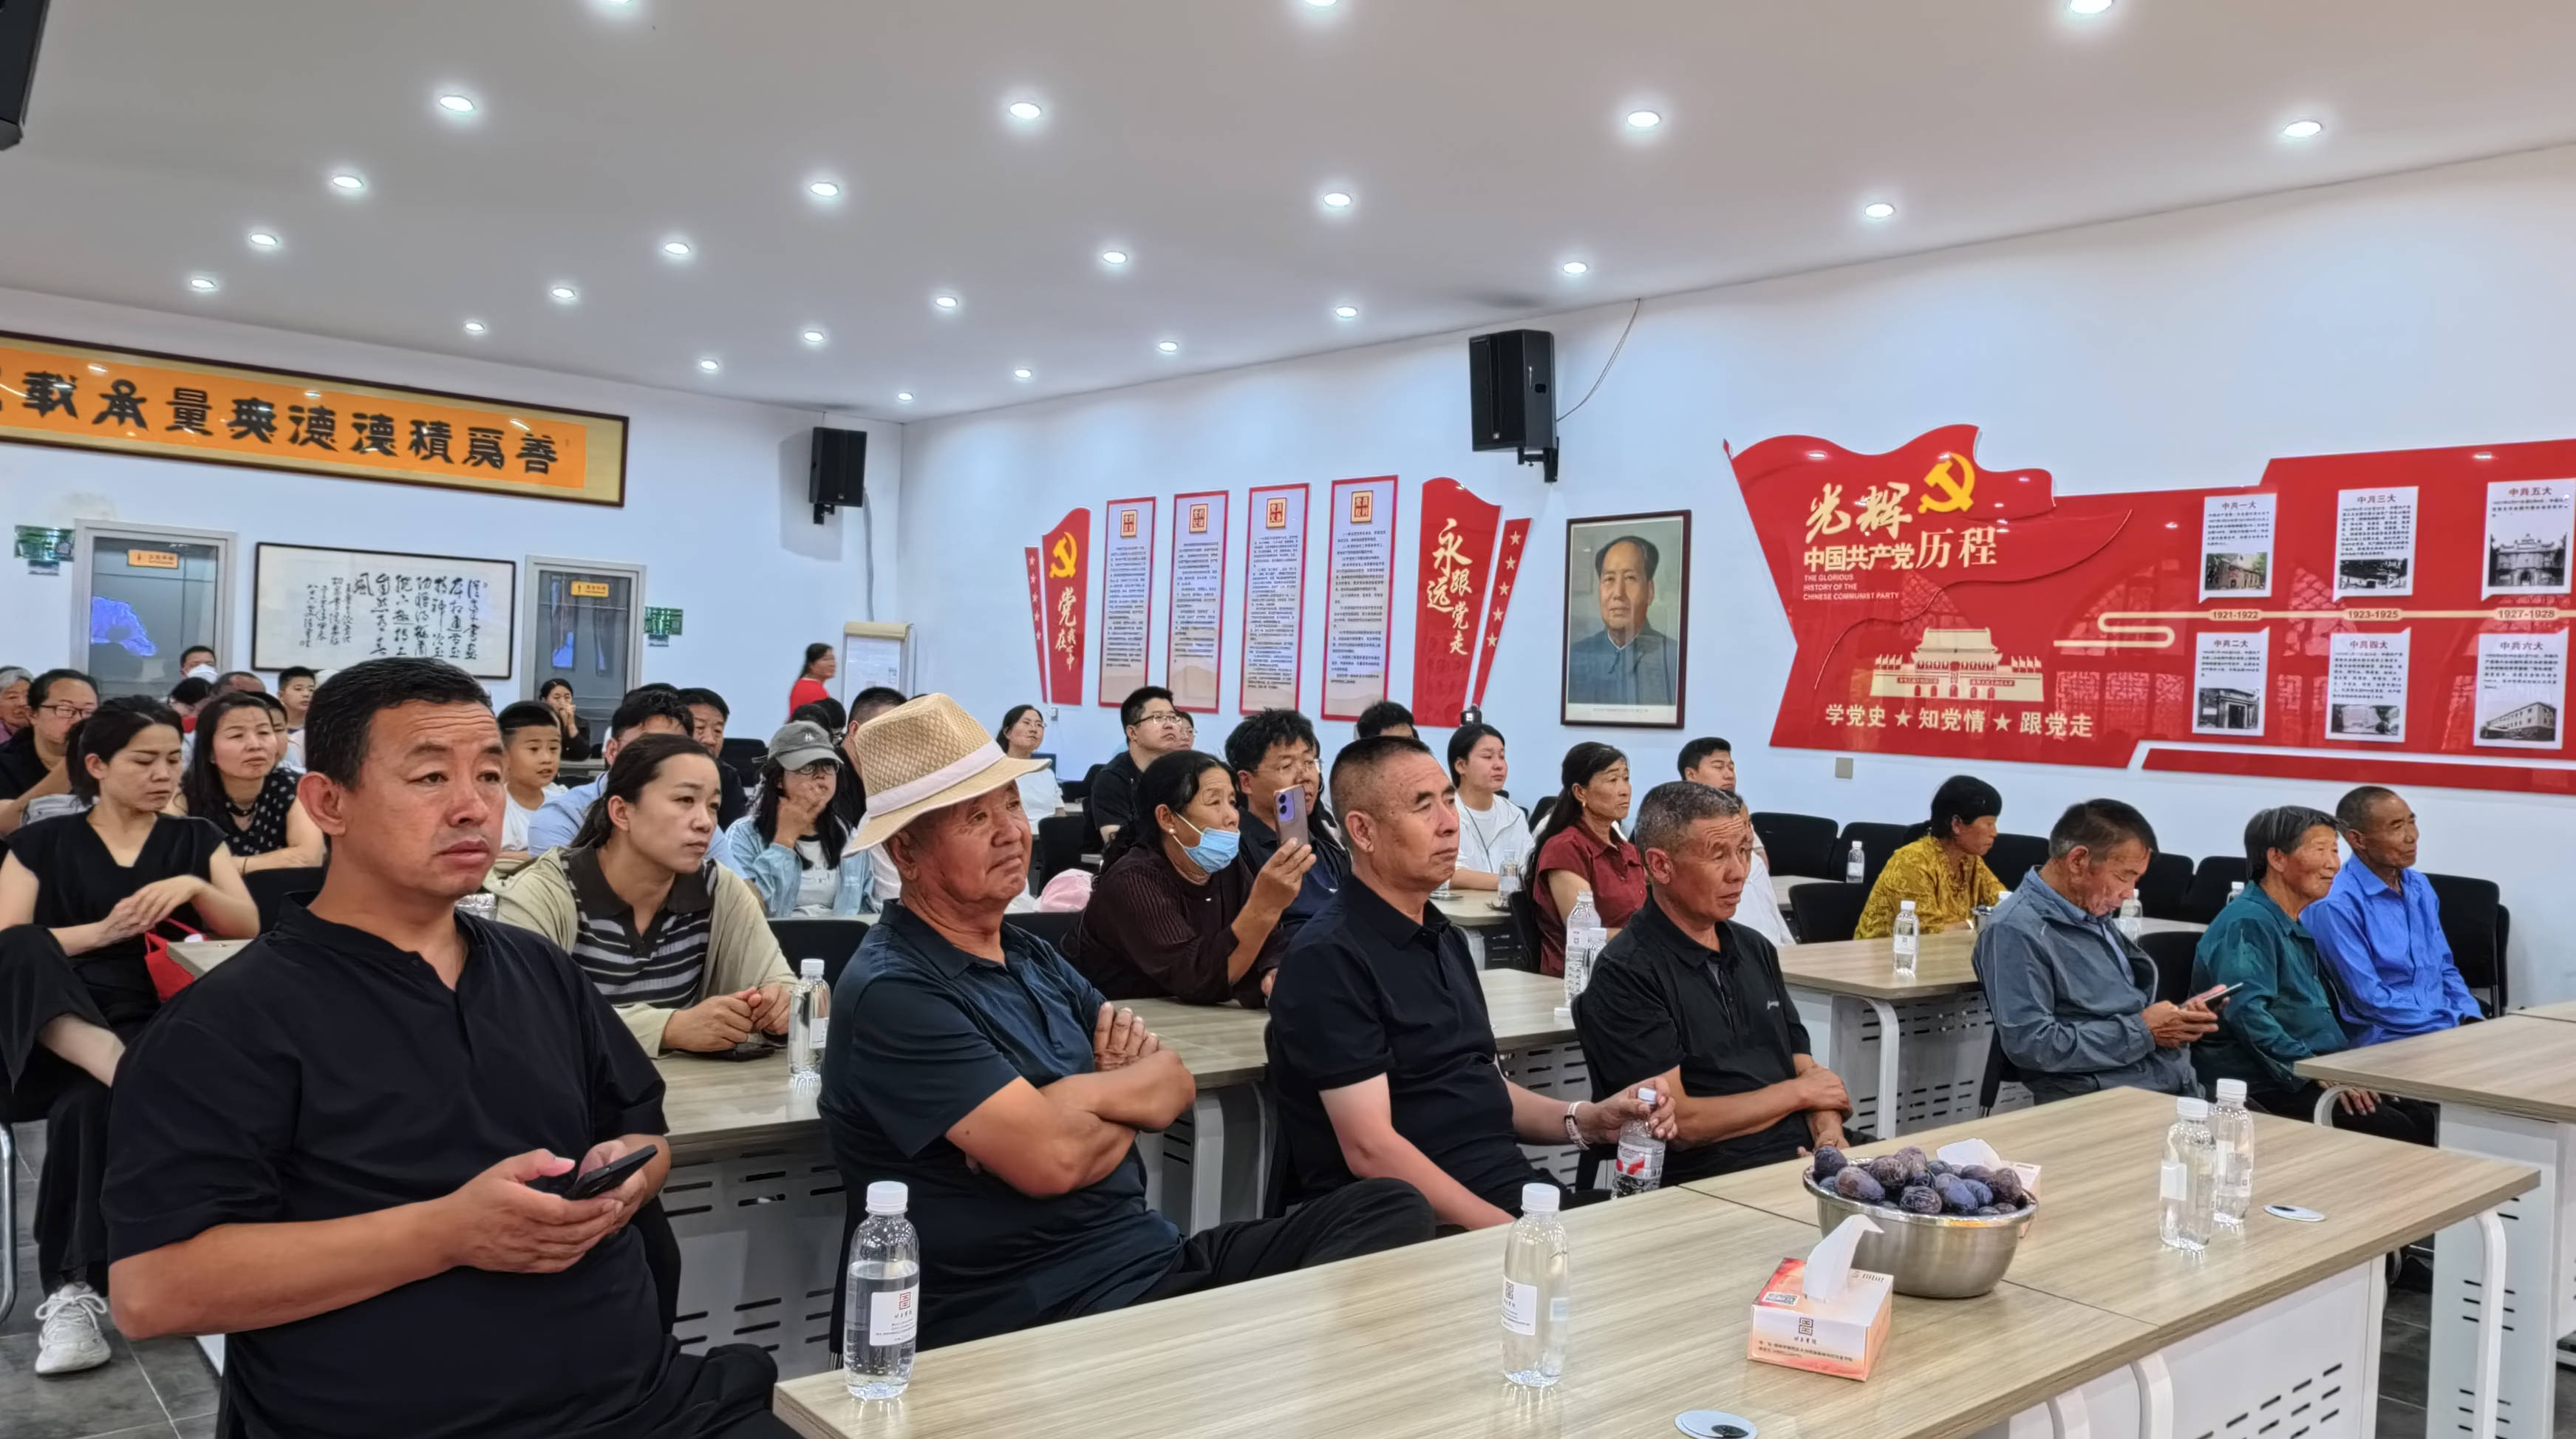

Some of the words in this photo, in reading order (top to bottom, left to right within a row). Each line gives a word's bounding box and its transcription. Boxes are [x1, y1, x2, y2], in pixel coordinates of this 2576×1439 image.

[2509, 486, 2552, 496] 中共五大
[2357, 494, 2396, 503] 中共三大
[2222, 500, 2258, 510] 中共一大
[1915, 525, 1997, 568] 历程
[1803, 583, 1832, 591] HISTORY
[1844, 582, 1857, 591] THE
[1833, 592, 1875, 600] COMMUNIST
[1876, 591, 1899, 599] PARTY
[2212, 610, 2259, 619] 1921-1922
[2348, 610, 2399, 619] 1923-1925
[2498, 609, 2555, 619] 1927-1928
[2214, 639, 2249, 647] 中共二大
[2349, 640, 2388, 649] 中共四大
[2500, 641, 2544, 650] 中共六大
[1825, 704, 1887, 727] 学党史
[1918, 707, 1986, 733] 知党情
[2019, 711, 2093, 738] 跟党走
